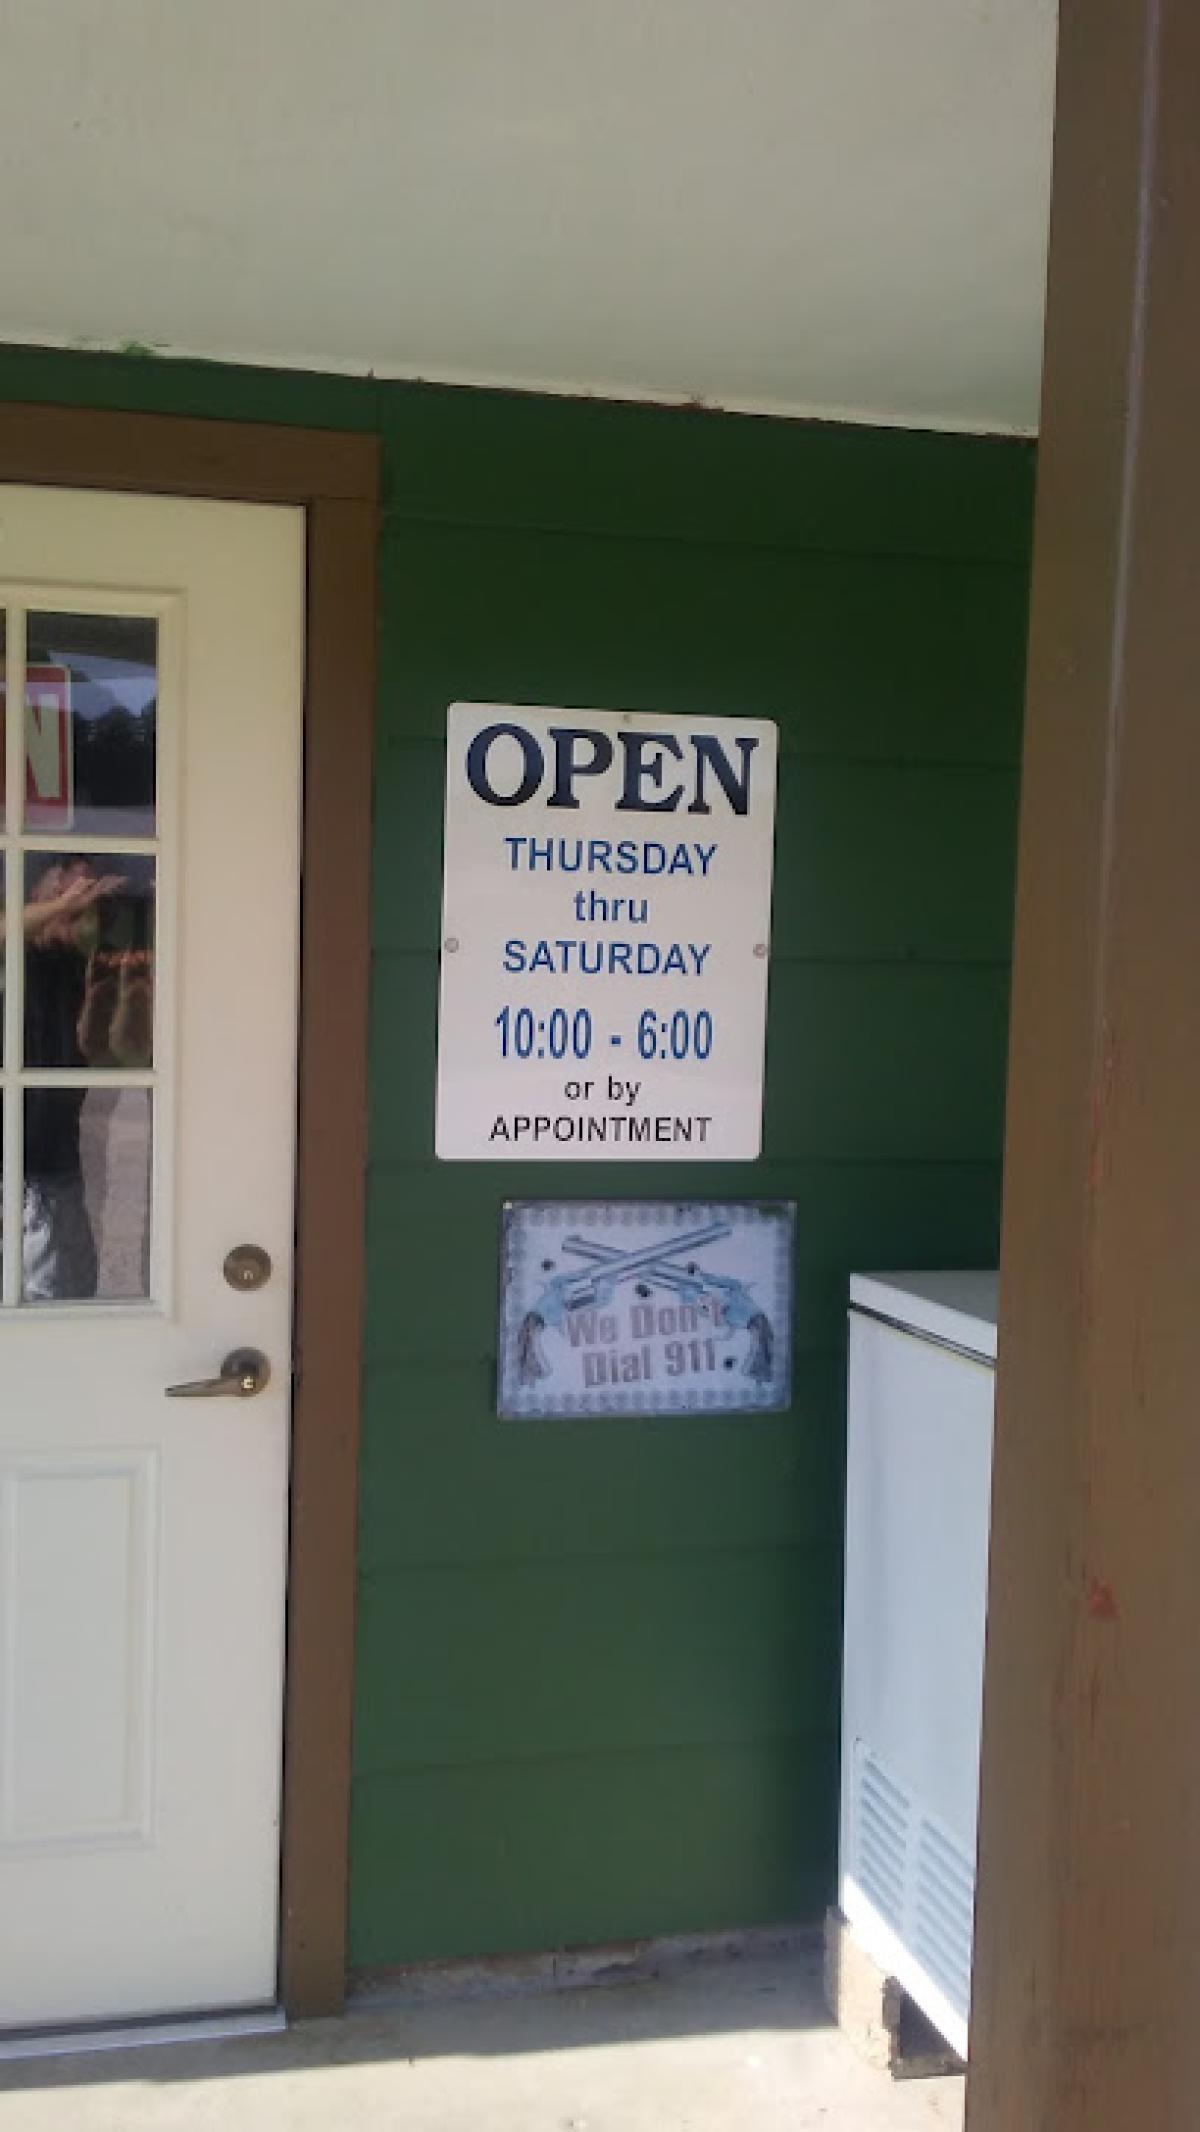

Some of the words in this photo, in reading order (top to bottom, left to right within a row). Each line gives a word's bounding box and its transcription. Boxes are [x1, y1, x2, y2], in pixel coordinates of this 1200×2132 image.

[466, 722, 760, 816] OPEN
[505, 837, 718, 876] THURSDAY
[574, 890, 648, 923] thru
[502, 940, 711, 977] SATURDAY
[495, 1005, 592, 1060] 10:00
[637, 1008, 713, 1060] 6:00
[564, 1080, 595, 1101] or
[608, 1075, 641, 1107] by
[488, 1116, 713, 1143] APPOINTMENT
[567, 1310, 618, 1347] We
[583, 1344, 651, 1388] Dial
[664, 1337, 716, 1376] 911
